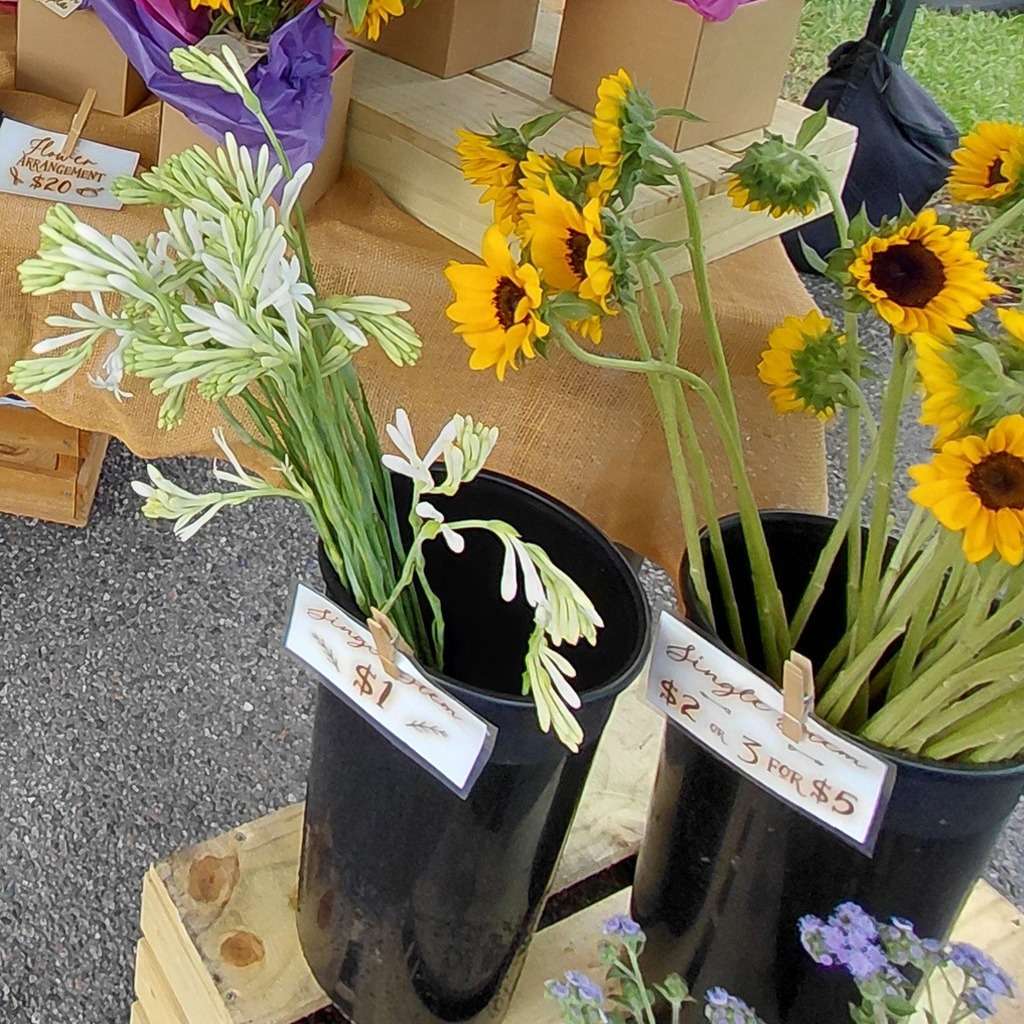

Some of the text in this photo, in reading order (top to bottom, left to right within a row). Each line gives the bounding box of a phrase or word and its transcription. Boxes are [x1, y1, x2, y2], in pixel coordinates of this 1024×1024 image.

[16, 150, 108, 184] ARRANGEMENT
[24, 136, 99, 166] Flower
[29, 174, 73, 194] $20
[352, 663, 394, 710] $1
[665, 643, 773, 712] Single
[659, 678, 858, 816] $2 OR 3 FOR $5
